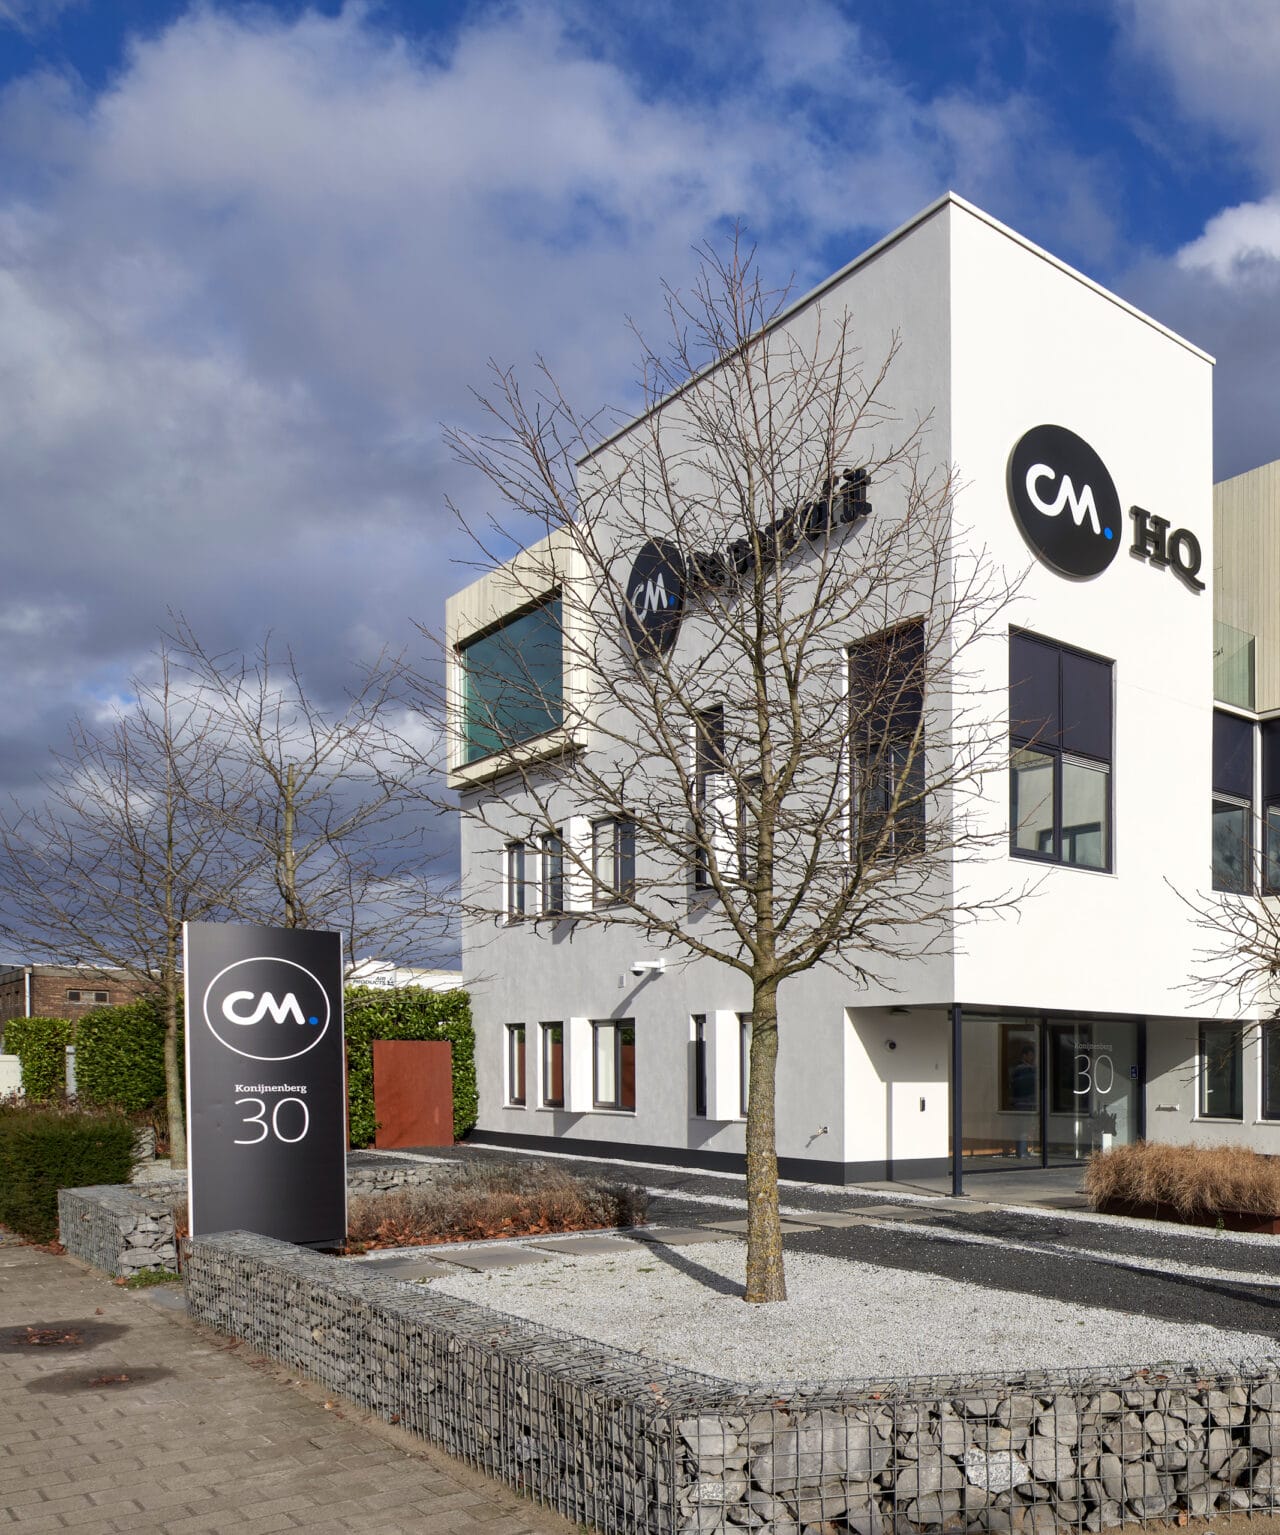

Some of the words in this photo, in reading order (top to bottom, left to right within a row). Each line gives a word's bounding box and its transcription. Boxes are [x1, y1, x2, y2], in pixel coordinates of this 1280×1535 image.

[1129, 505, 1206, 592] HQ
[234, 1083, 308, 1094] Konijnenberg
[1073, 1054, 1113, 1094] 30
[233, 1097, 310, 1145] 30
